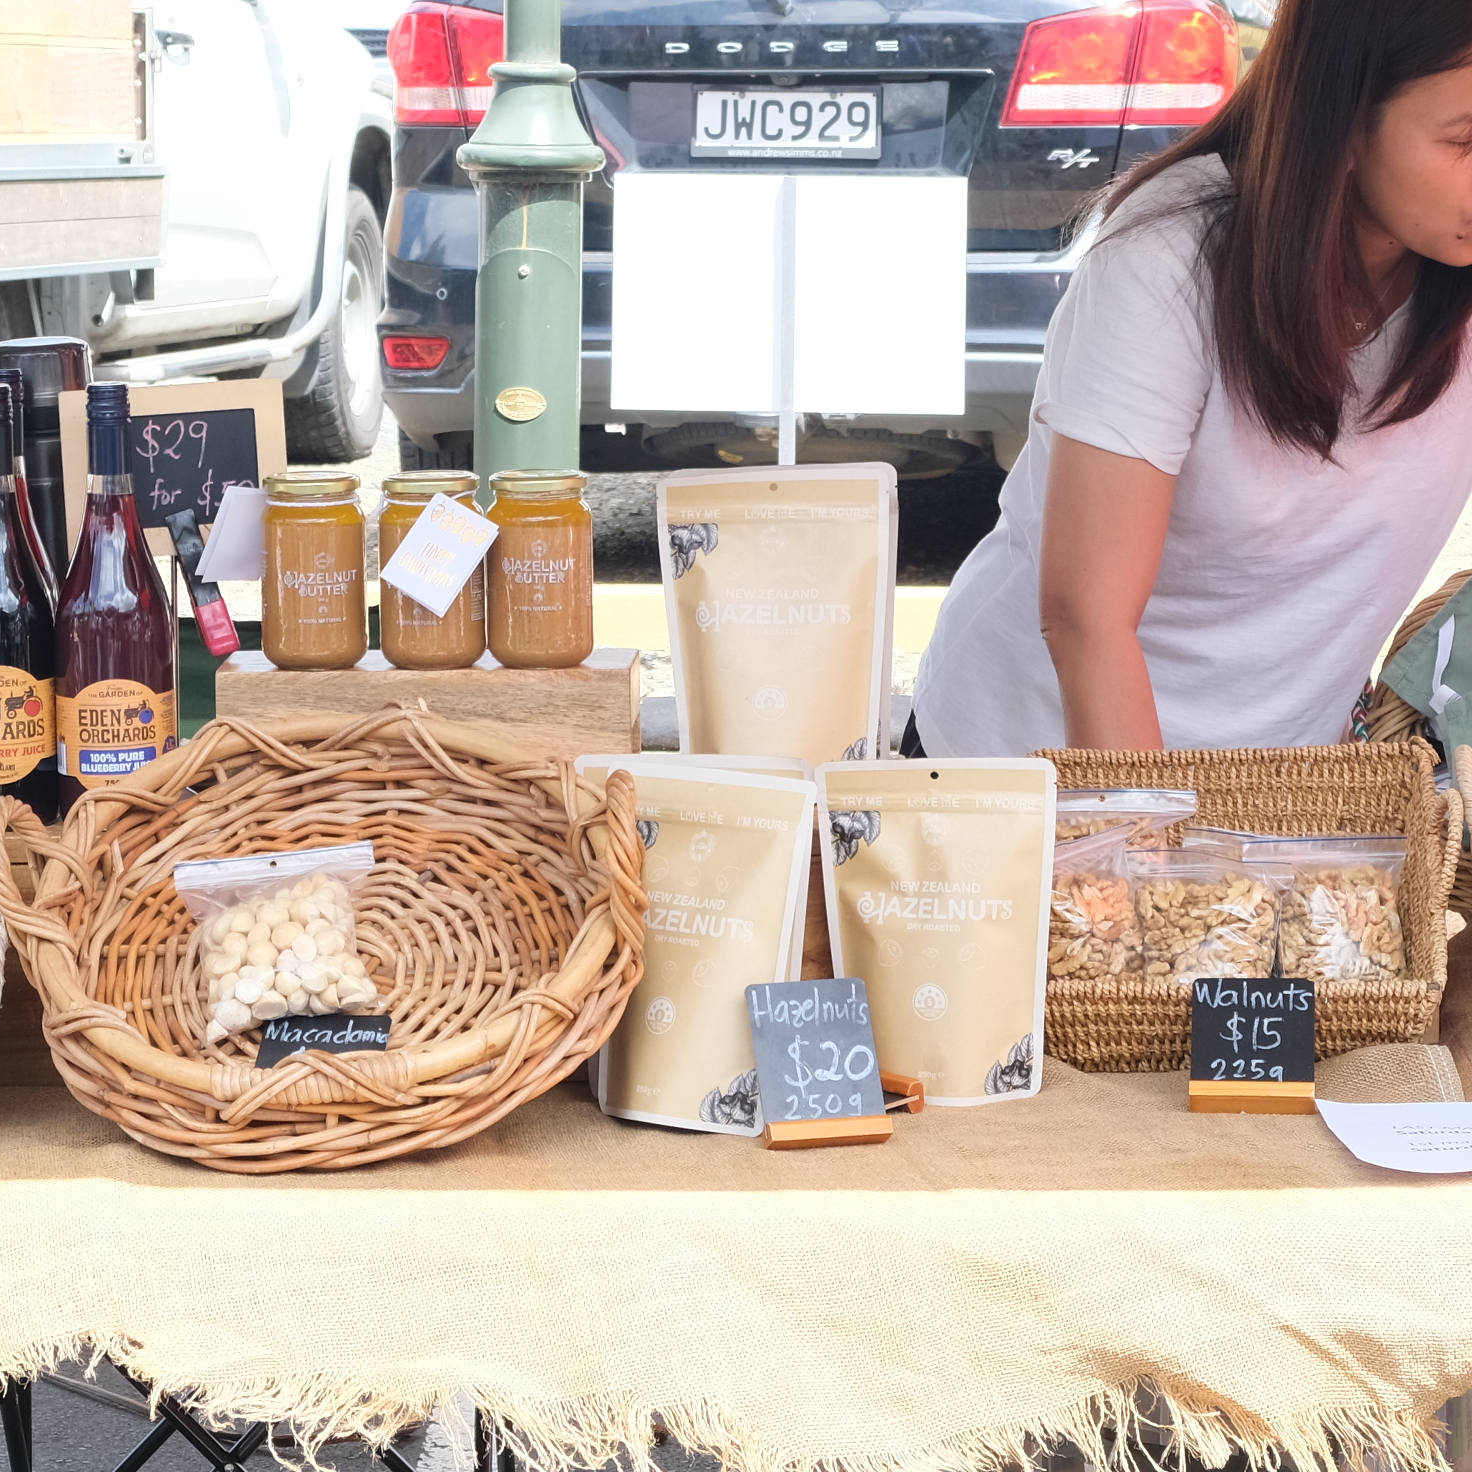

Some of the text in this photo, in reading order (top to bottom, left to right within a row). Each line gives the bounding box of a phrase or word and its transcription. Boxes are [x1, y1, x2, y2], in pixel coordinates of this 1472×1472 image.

[665, 39, 899, 53] DODGE
[703, 98, 871, 142] JWC929
[727, 147, 843, 159] www.andrewsimms.co.nz
[136, 419, 208, 473] $29
[149, 477, 182, 511] for
[681, 509, 721, 520] TRY ME
[744, 509, 774, 520] LOVE
[829, 507, 869, 518] YOURS
[501, 557, 576, 575] HAZELNUT
[283, 569, 357, 589] HAZELNUT
[514, 572, 566, 584] BUTTER
[298, 583, 348, 597] BUTTER
[726, 588, 820, 599] NEW ZEALAND
[695, 600, 852, 633] HAZELNUTS
[98, 689, 136, 698] GARDEN
[78, 709, 121, 727] EDEN
[79, 725, 156, 743] ORCHARDS
[22, 744, 46, 756] JUICE
[90, 751, 145, 763] 100% PURE
[81, 762, 132, 773] BLUEBERRY
[841, 797, 882, 807] TRY ME
[907, 797, 939, 807] LOVE
[994, 798, 1034, 809] YOURS
[646, 807, 661, 818] ME
[680, 810, 706, 823] LOVE
[753, 817, 789, 831] YOURS
[891, 880, 981, 894] NEW ZEALAND
[647, 890, 726, 911] NEW ZEALAND
[856, 891, 1014, 925] HAZELNUTS
[643, 908, 755, 943] AZELNUTS
[923, 924, 960, 932] ROASTED
[654, 934, 700, 947] DRY ROASTED
[1194, 978, 1314, 1012] Walnuts
[751, 983, 868, 1029] Hazelnuts
[1219, 1011, 1285, 1054] $15
[784, 1034, 876, 1098] $20
[1210, 1058, 1284, 1082] 225g
[784, 1092, 863, 1120] 250g
